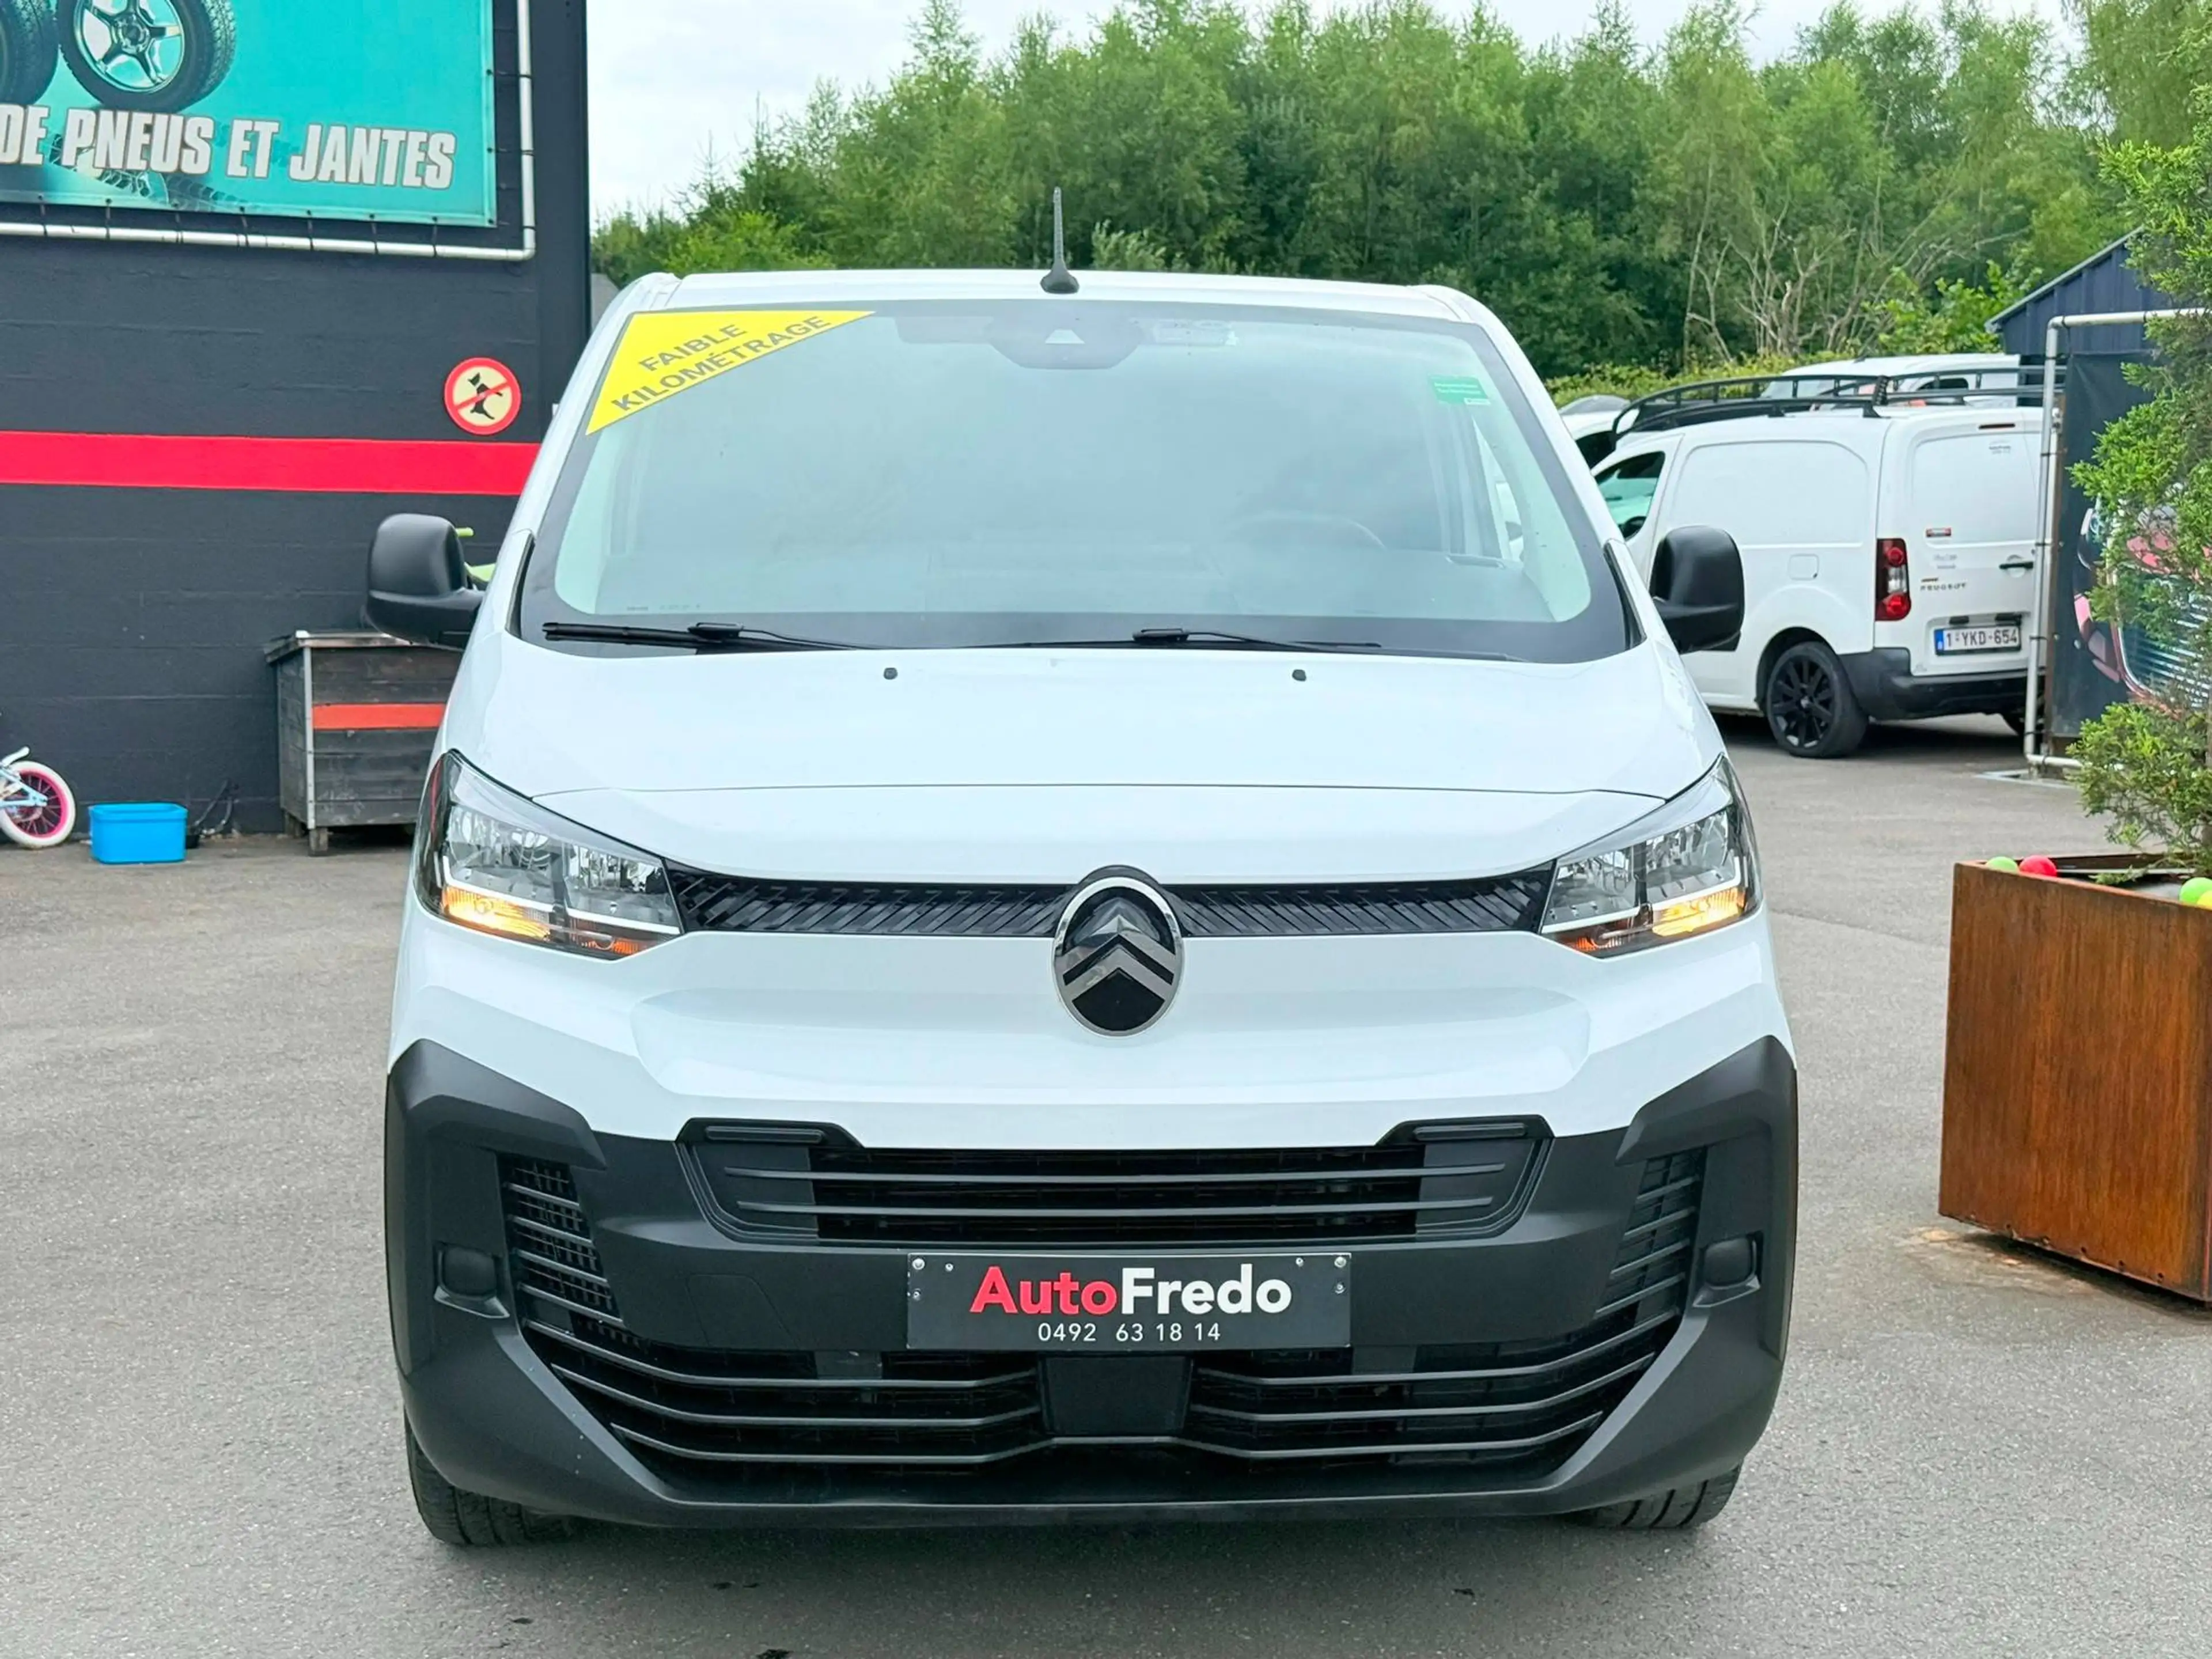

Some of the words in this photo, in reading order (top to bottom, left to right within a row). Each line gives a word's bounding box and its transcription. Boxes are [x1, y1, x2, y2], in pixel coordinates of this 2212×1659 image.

[0, 104, 50, 165] DE
[61, 107, 215, 174] PNEUS
[225, 118, 280, 178] ET
[289, 123, 457, 190] JANTES
[611, 316, 832, 411] KILOMÉTRAGE
[638, 324, 747, 372] FAIBLE
[969, 1263, 1291, 1315] AutoFredo
[1037, 1323, 1096, 1342] 0492
[1115, 1323, 1143, 1342] 63
[1157, 1323, 1183, 1342] 18
[1195, 1323, 1221, 1342] 14
